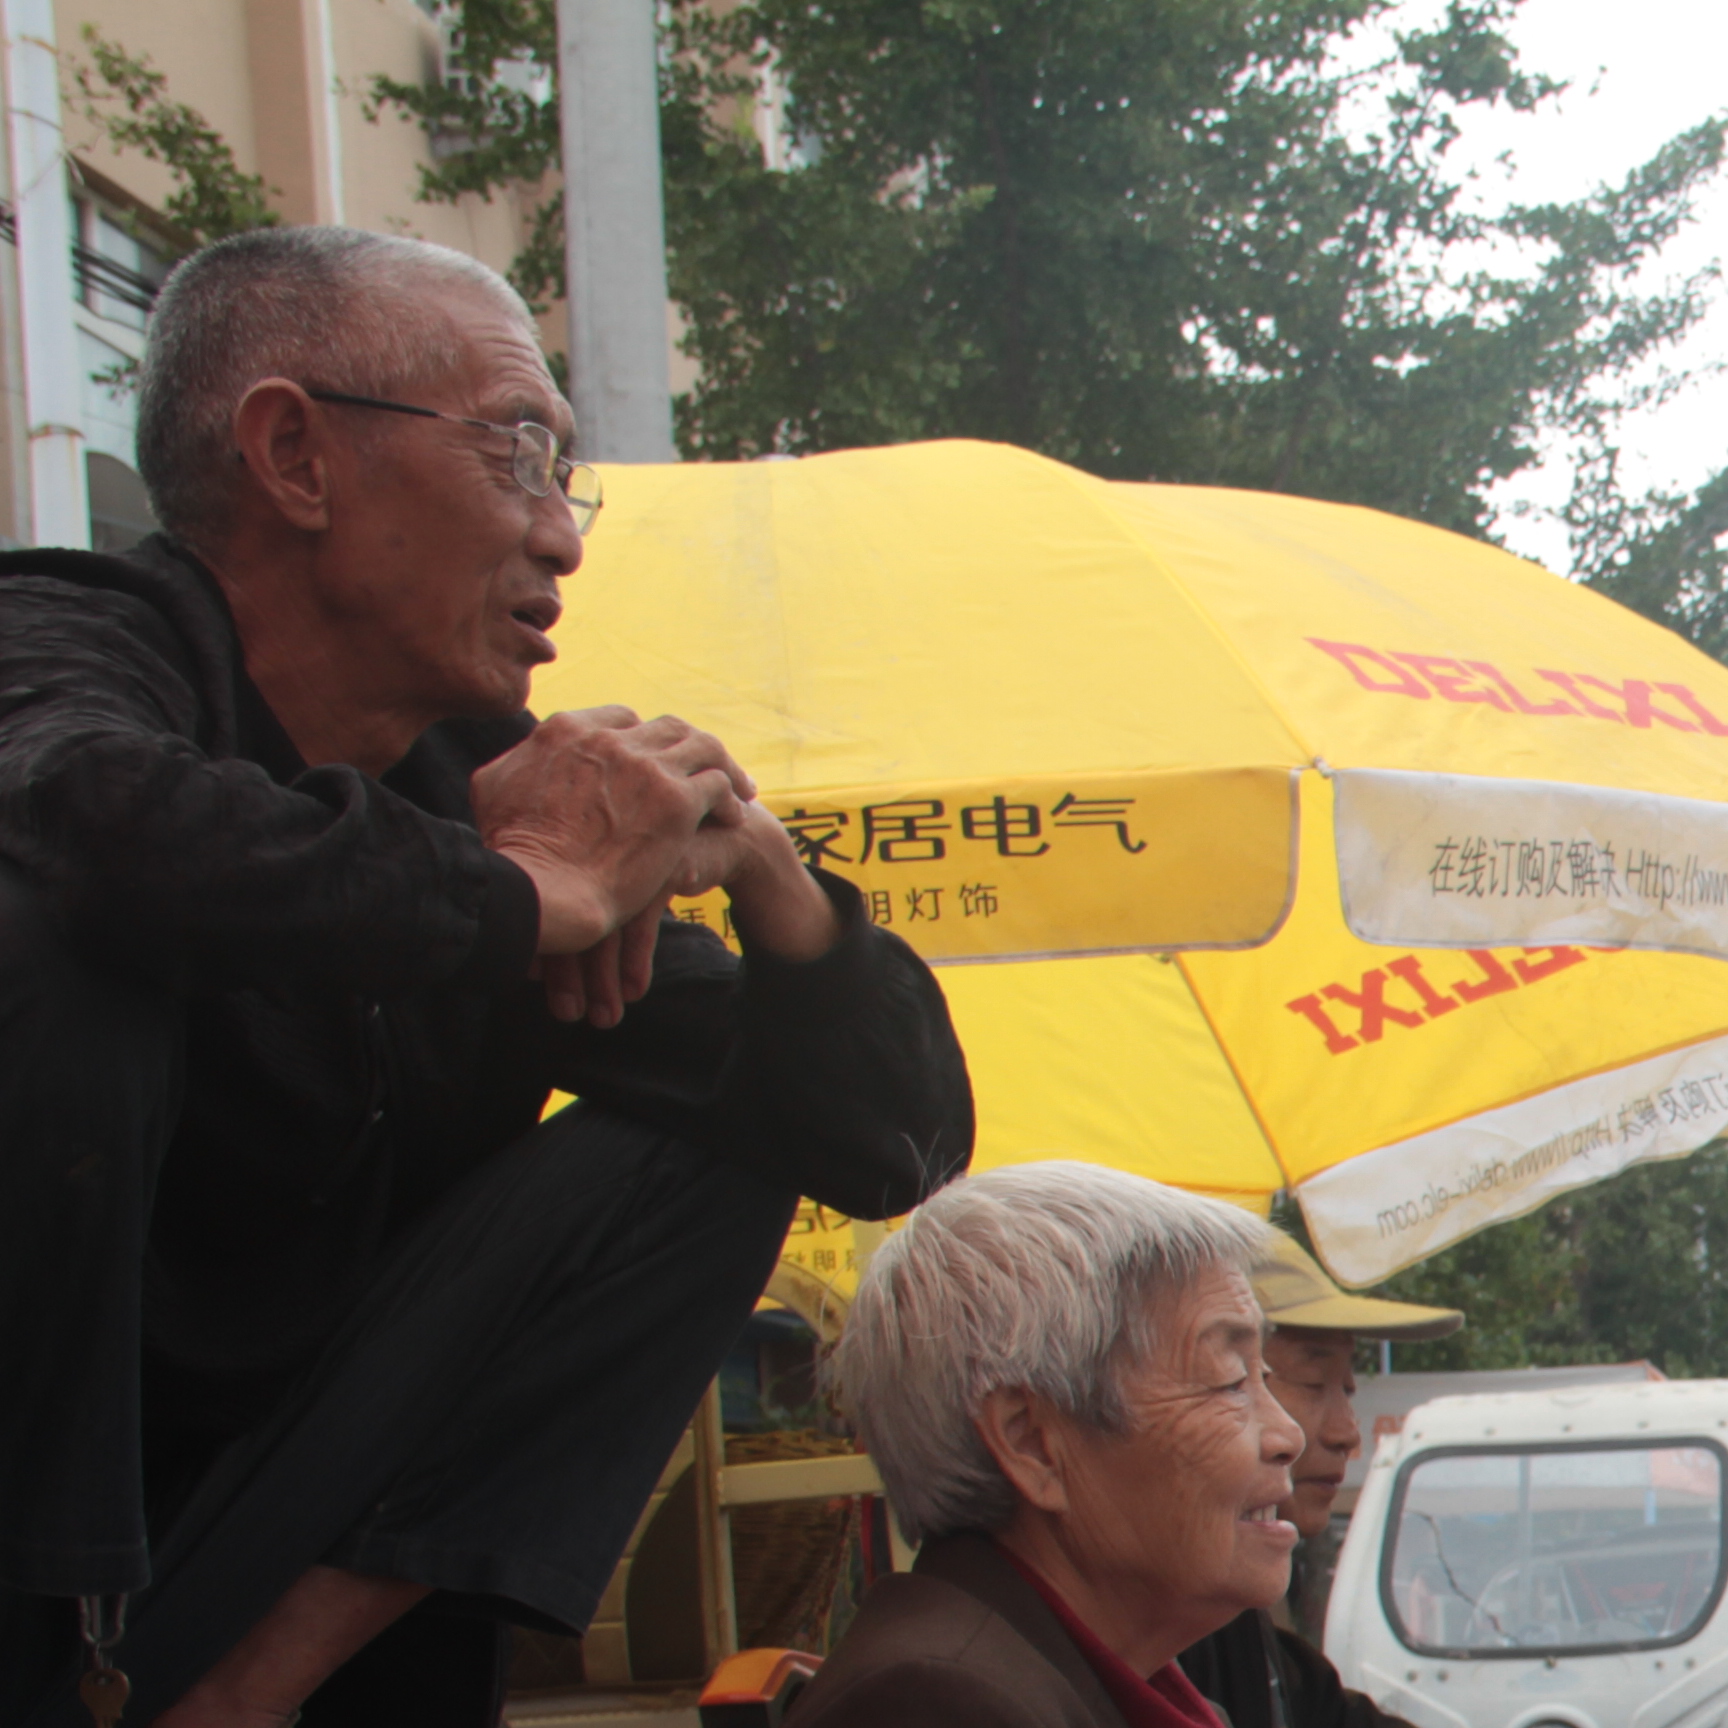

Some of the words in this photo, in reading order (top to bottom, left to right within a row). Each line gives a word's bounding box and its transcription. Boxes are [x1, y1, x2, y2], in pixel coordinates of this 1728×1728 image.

[1428, 836, 1622, 899] 在线订购及解决
